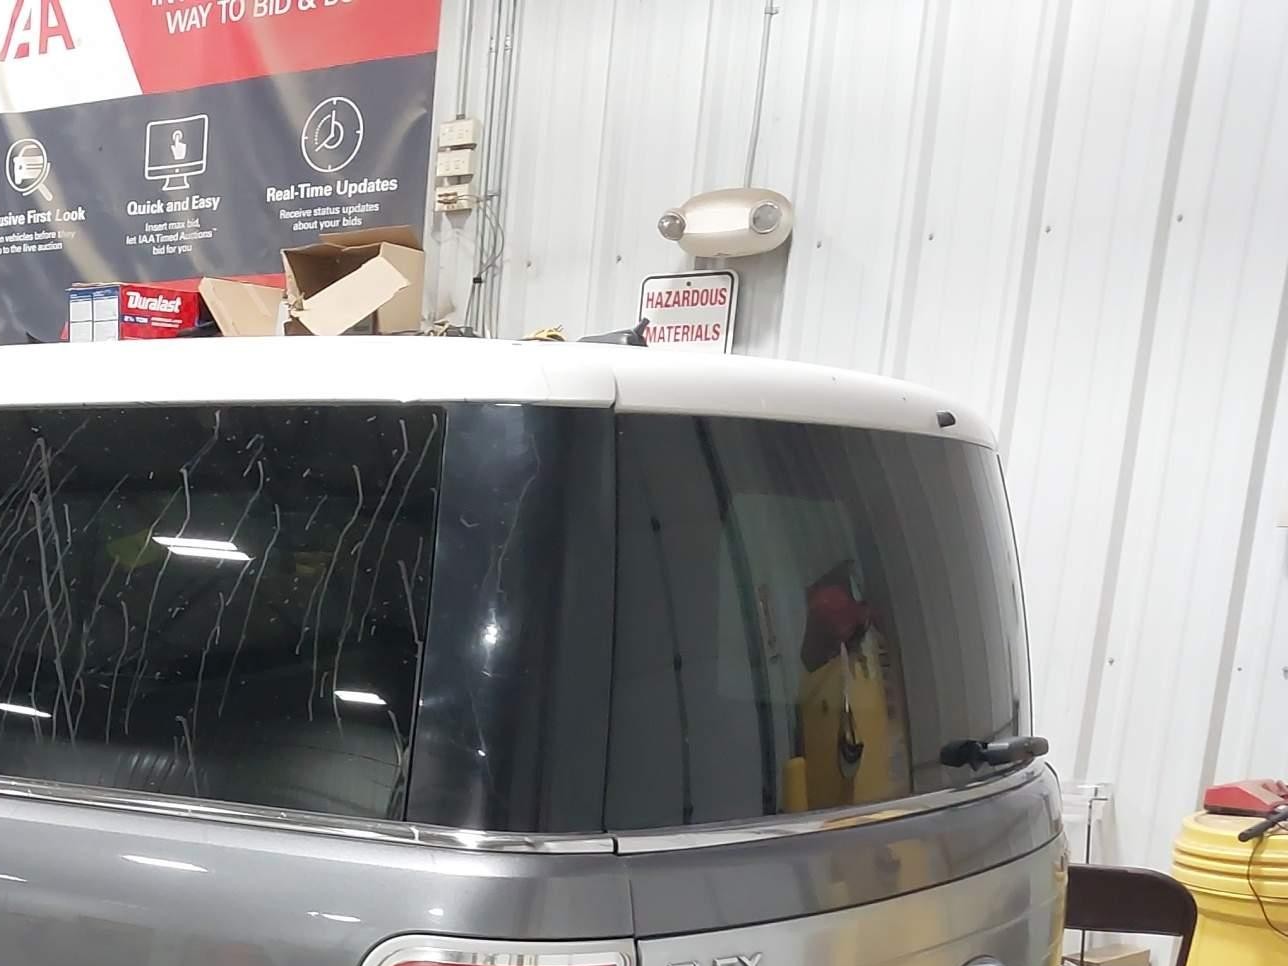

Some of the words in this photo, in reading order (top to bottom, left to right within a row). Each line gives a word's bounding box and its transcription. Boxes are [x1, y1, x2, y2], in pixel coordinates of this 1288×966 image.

[166, 3, 212, 34] WAY
[217, 0, 245, 24] TO
[253, 0, 291, 18] BID
[266, 183, 332, 202] Real-Time
[336, 178, 398, 198] Updates
[127, 199, 164, 215] Quick
[166, 197, 189, 213] and
[192, 195, 221, 211] Easy
[279, 208, 312, 219] Receive
[313, 205, 340, 217] status
[342, 202, 379, 216] updates
[27, 209, 52, 224] First
[55, 206, 86, 222] Look
[293, 220, 317, 231] about
[319, 219, 341, 230] your
[342, 216, 362, 227] bids
[145, 222, 167, 232] Insert
[5, 232, 33, 243] vehicles
[34, 230, 56, 240] before
[126, 235, 136, 245] let
[138, 234, 155, 244] IAA
[155, 232, 178, 243] Timed
[3, 246, 10, 254] to
[10, 244, 22, 254] the
[23, 243, 37, 252] live
[38, 241, 63, 252] auction
[152, 245, 165, 255] bid
[166, 244, 177, 254] for
[178, 244, 192, 254] you
[126, 291, 182, 313] Duralast
[646, 287, 727, 309] HAZARDOUS
[644, 323, 721, 343] MATERIALS
